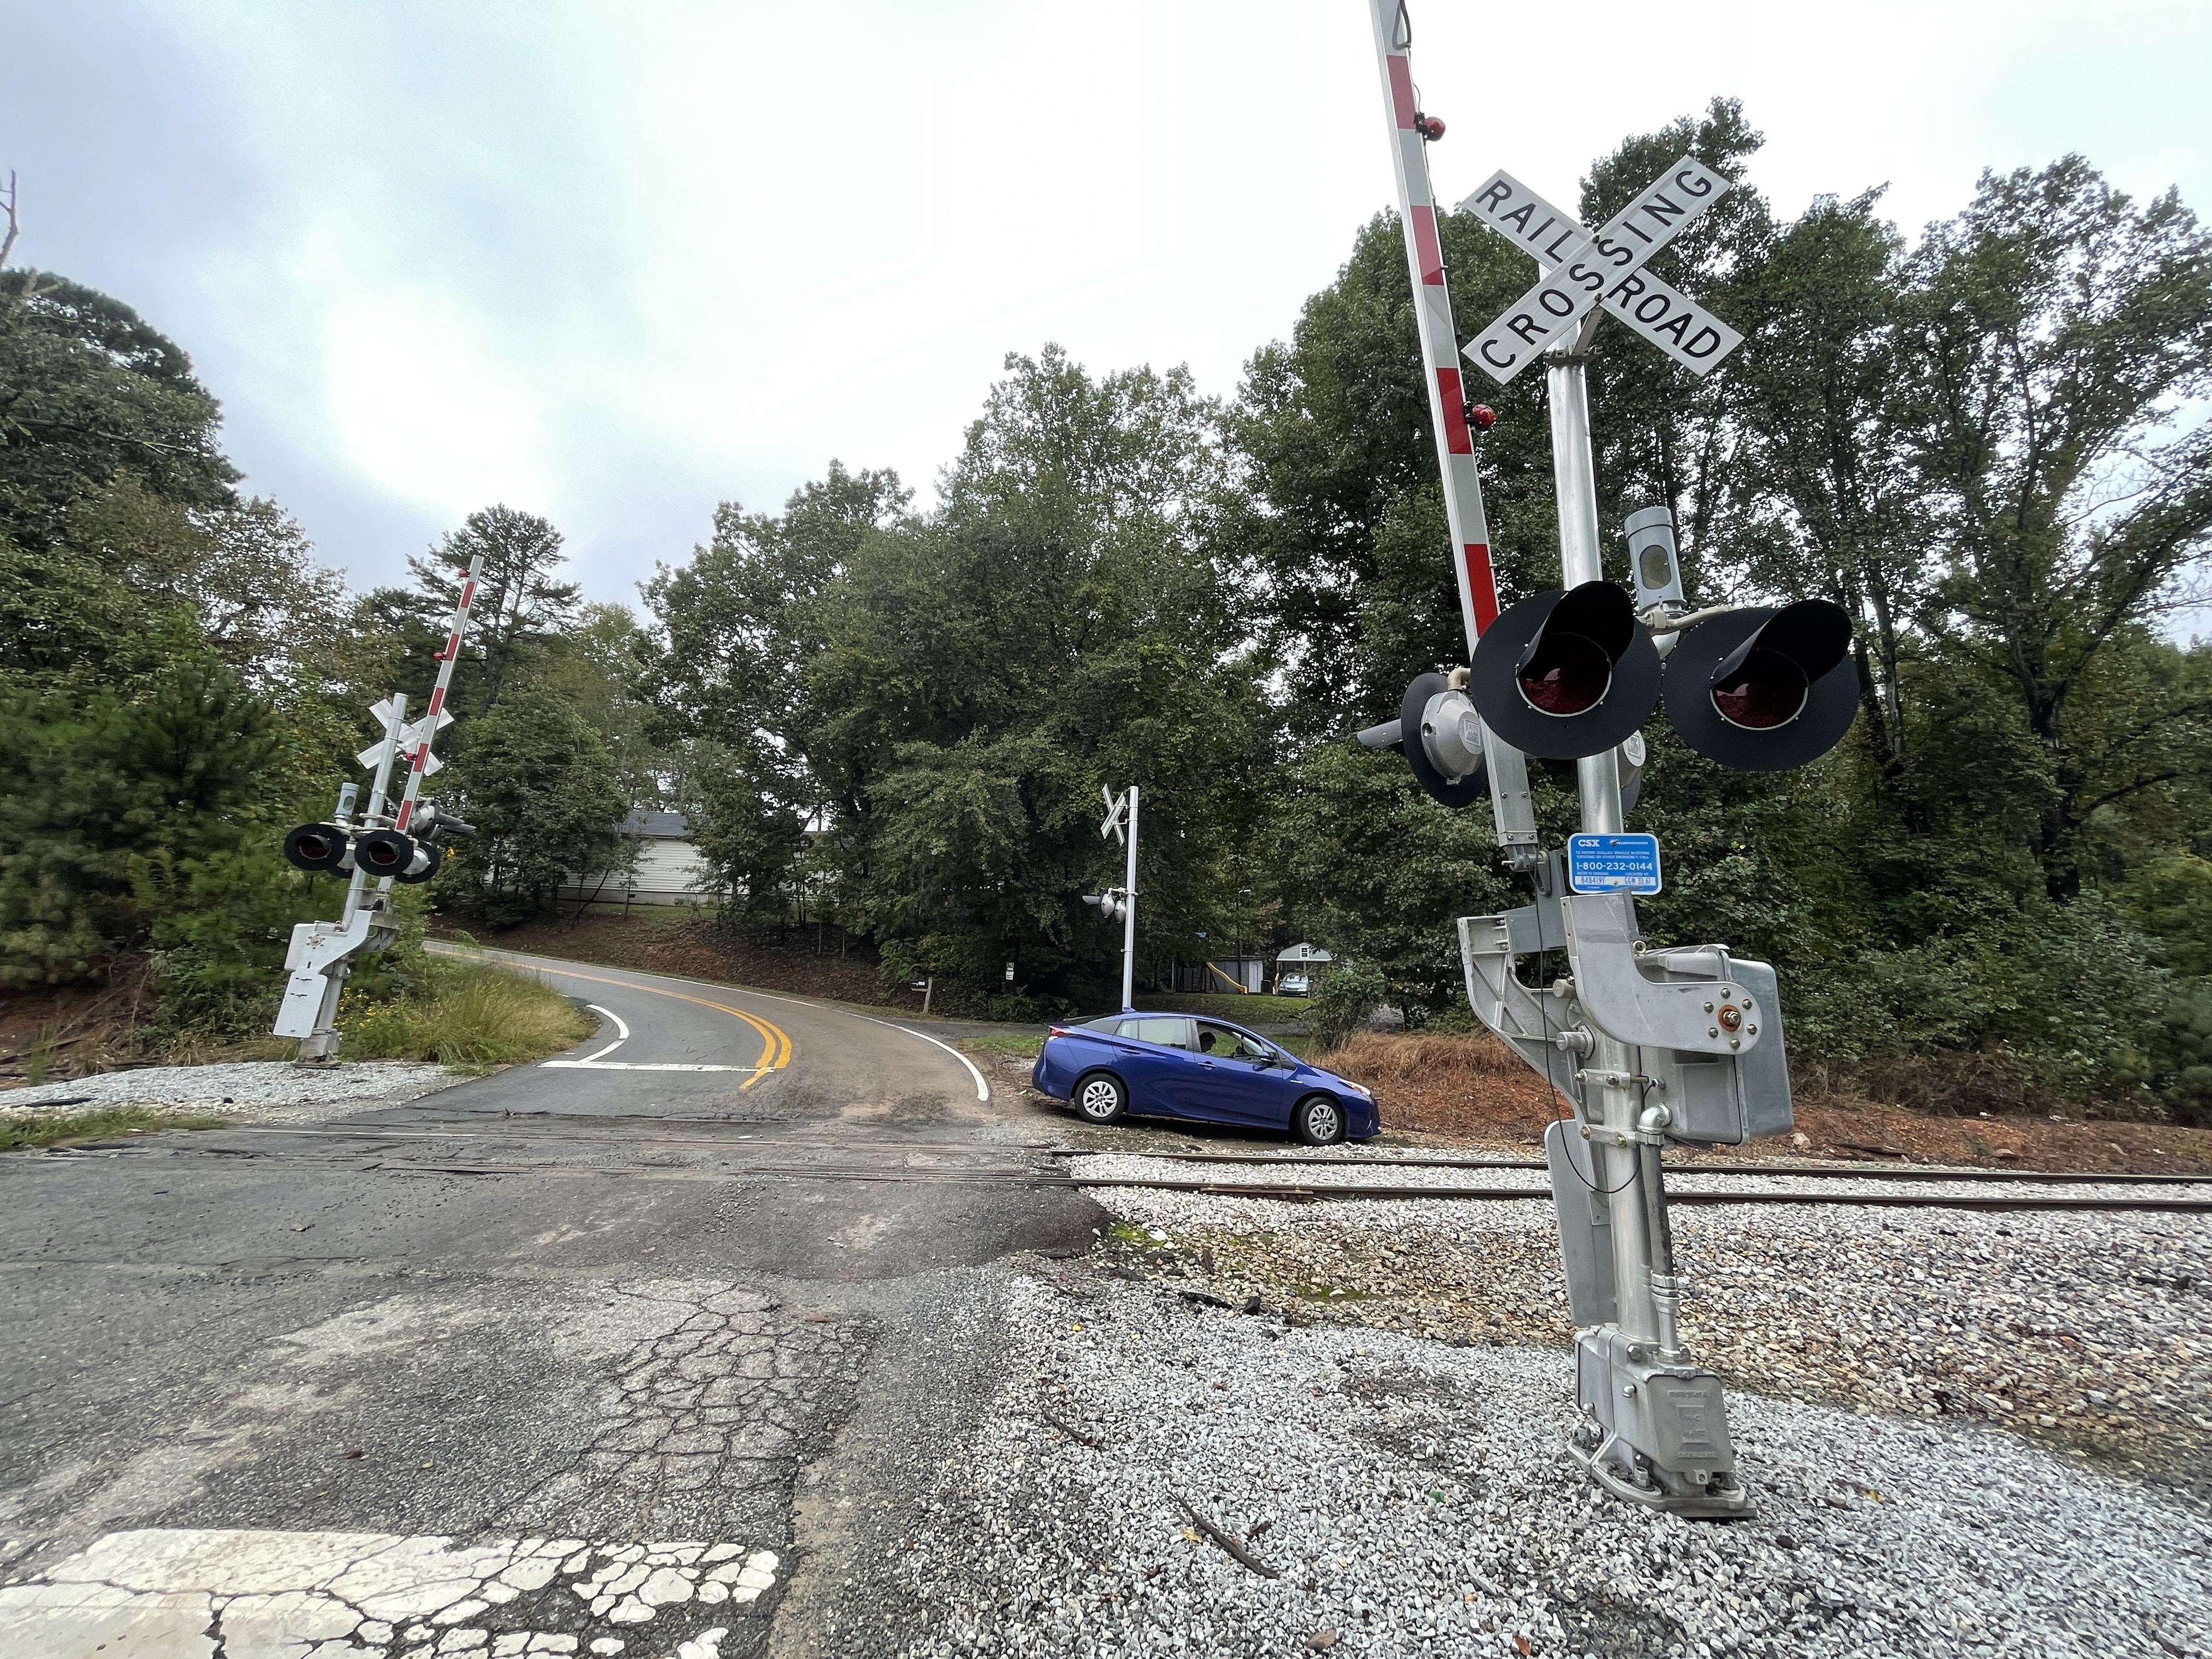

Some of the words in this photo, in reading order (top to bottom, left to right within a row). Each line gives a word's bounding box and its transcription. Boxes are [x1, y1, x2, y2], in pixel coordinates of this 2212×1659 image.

[1475, 179, 1574, 264] RAIL
[1607, 275, 1722, 359] ROAD
[1481, 170, 1712, 369] CROSSING
[1576, 862, 1652, 871] 1-800-232-0144
